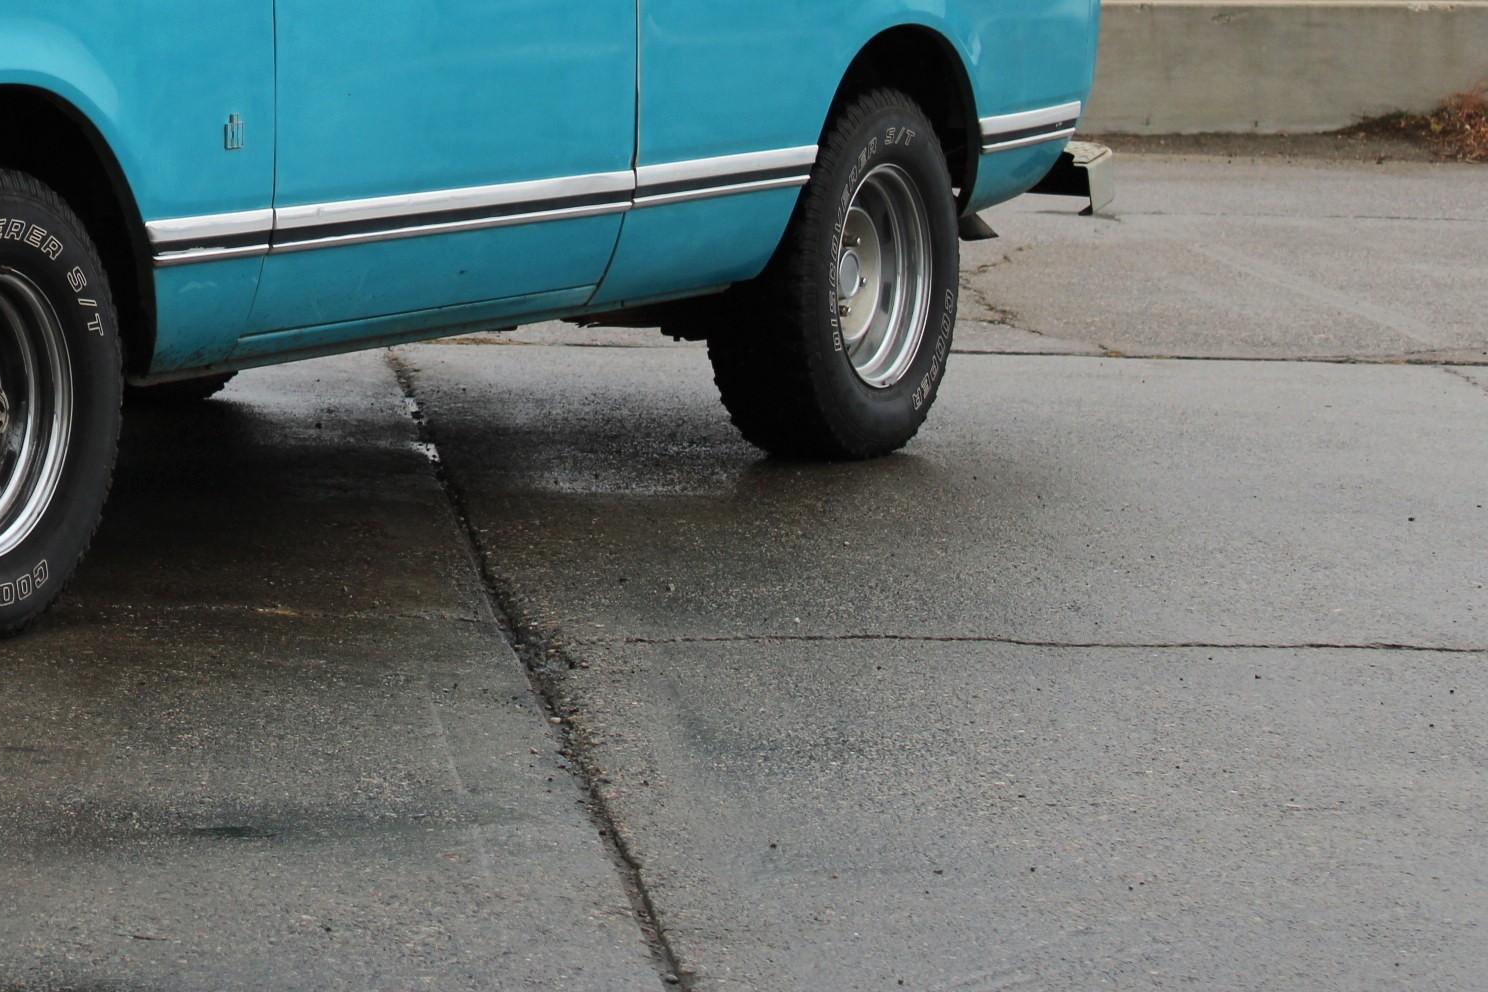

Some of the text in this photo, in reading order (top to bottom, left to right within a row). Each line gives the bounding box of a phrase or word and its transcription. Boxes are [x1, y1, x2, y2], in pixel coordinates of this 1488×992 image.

[884, 126, 916, 147] S/T
[67, 265, 104, 337] S/T
[912, 288, 954, 411] COOPER
